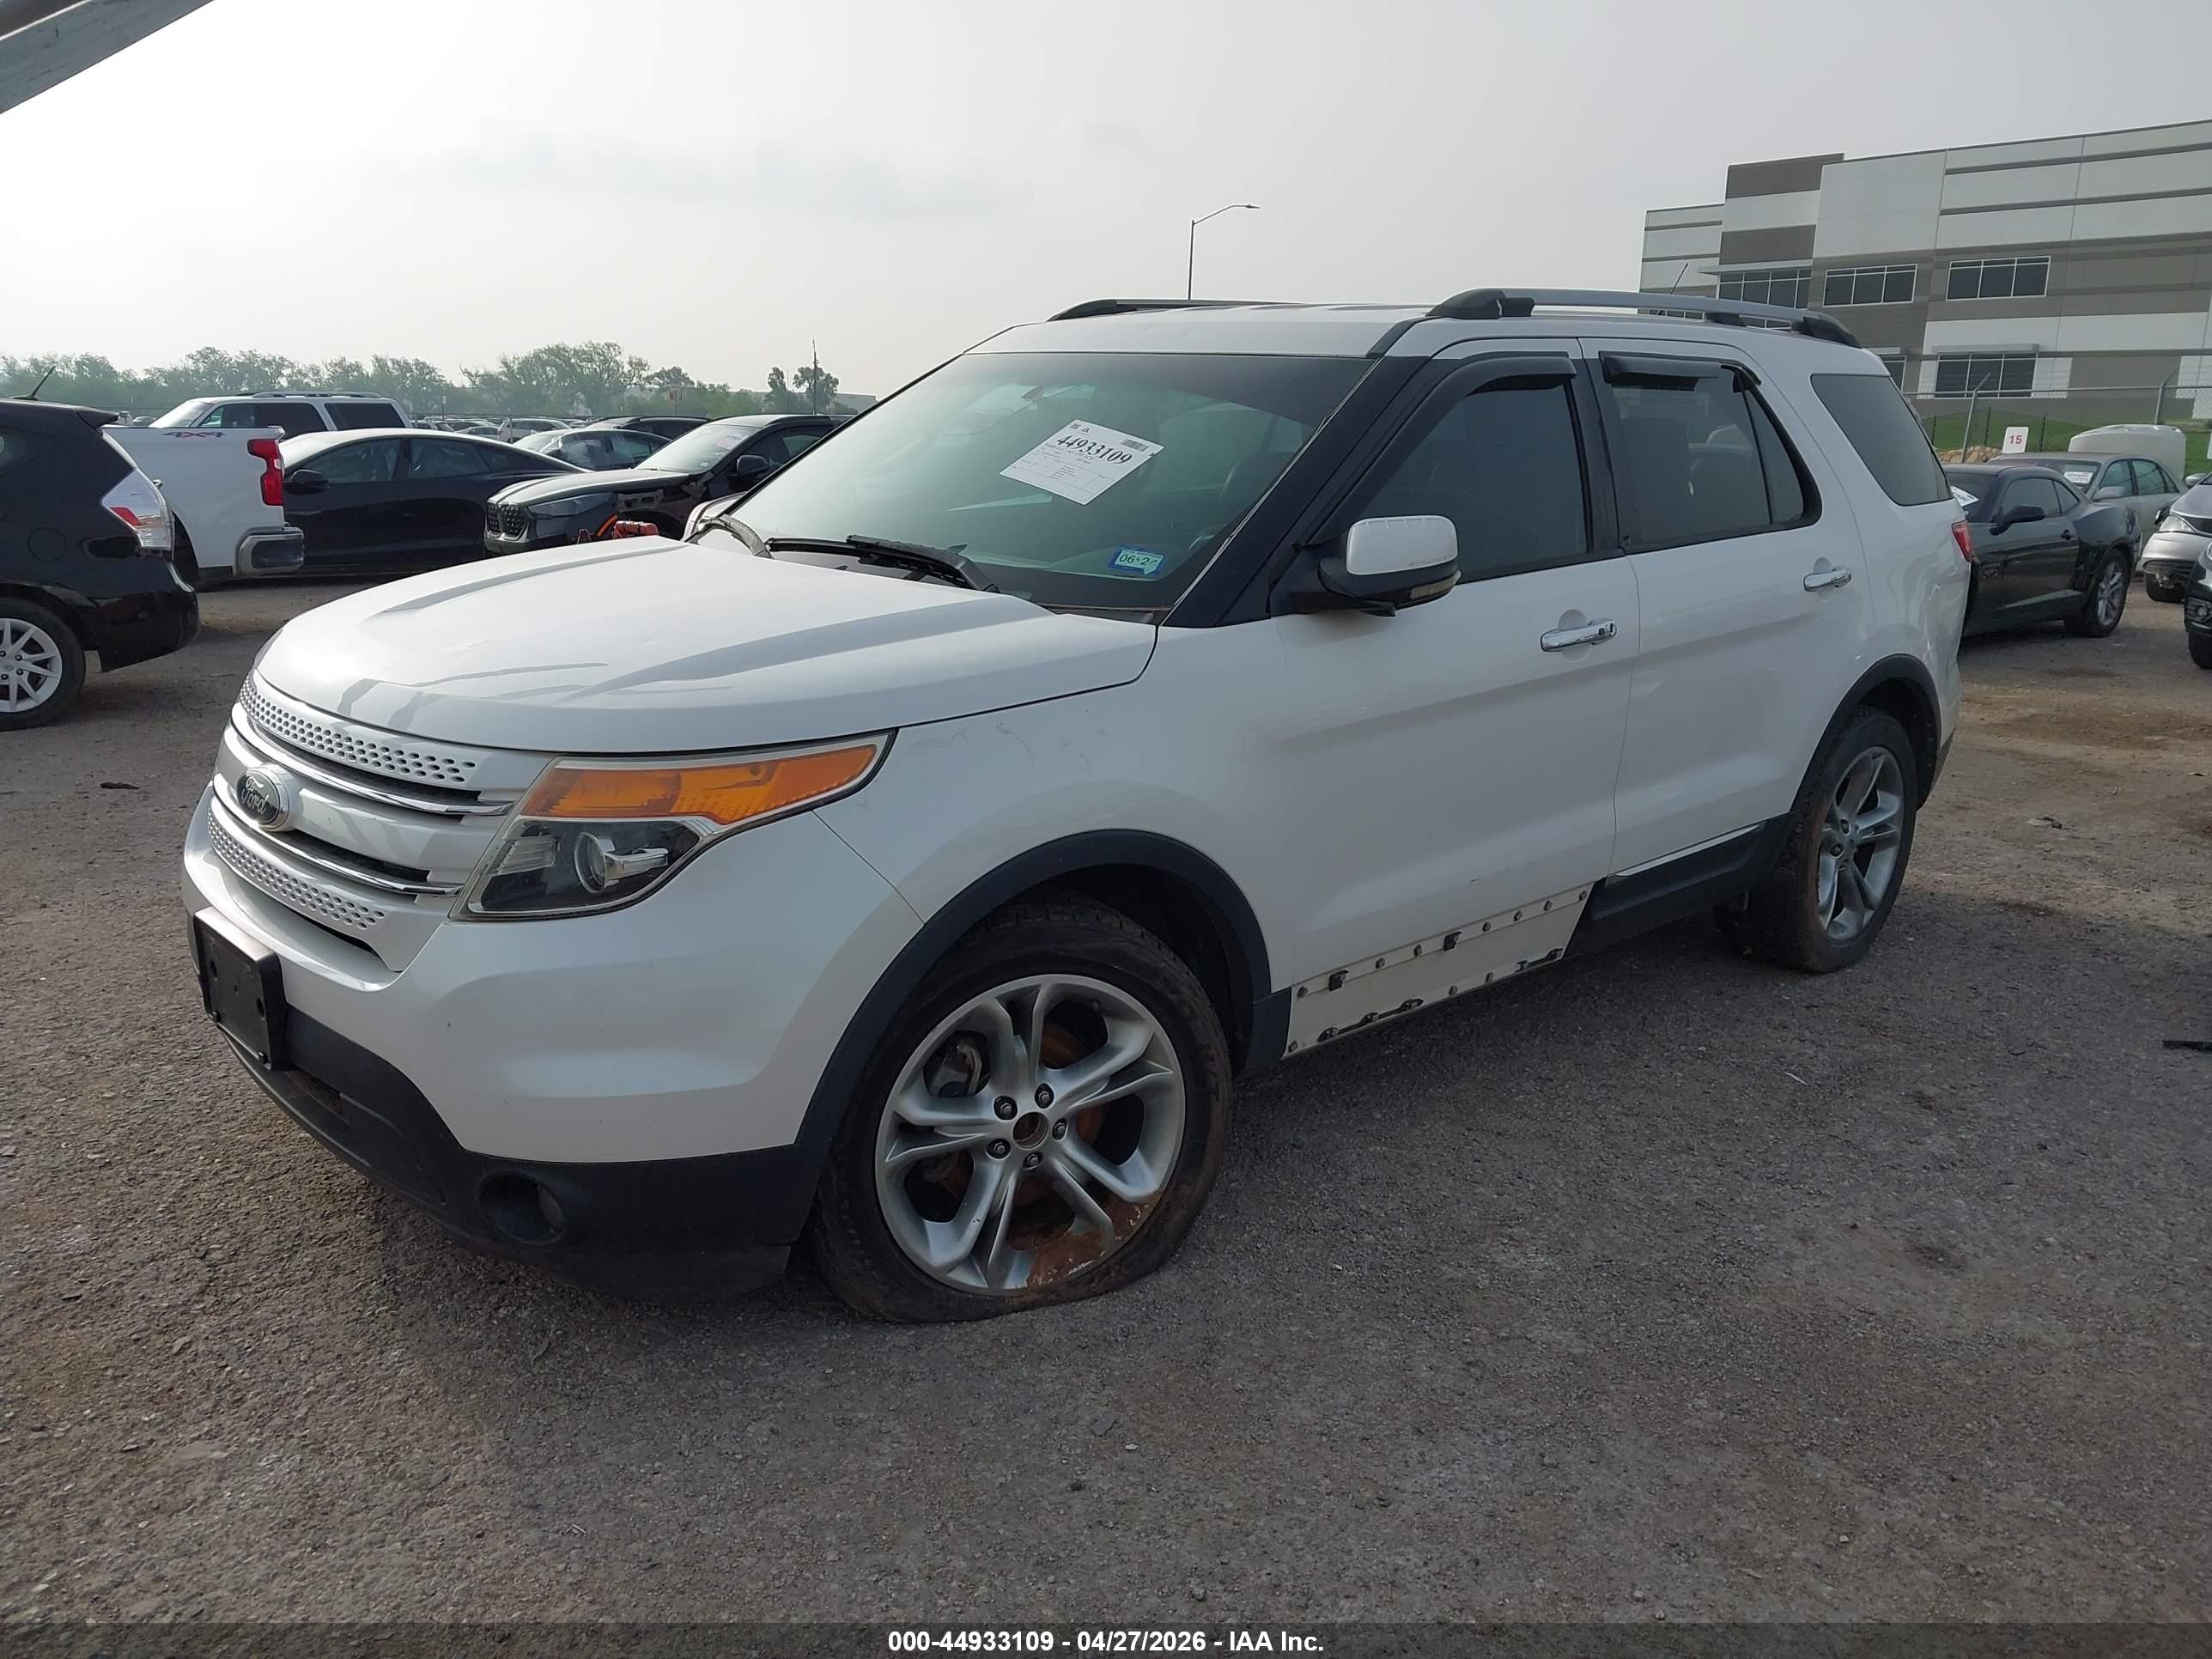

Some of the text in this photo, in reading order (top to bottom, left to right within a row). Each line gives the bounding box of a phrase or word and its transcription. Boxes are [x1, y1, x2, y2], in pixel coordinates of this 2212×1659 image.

[1057, 434, 1133, 465] 44933109
[2009, 434, 2023, 444] 15
[241, 775, 270, 815] Ford
